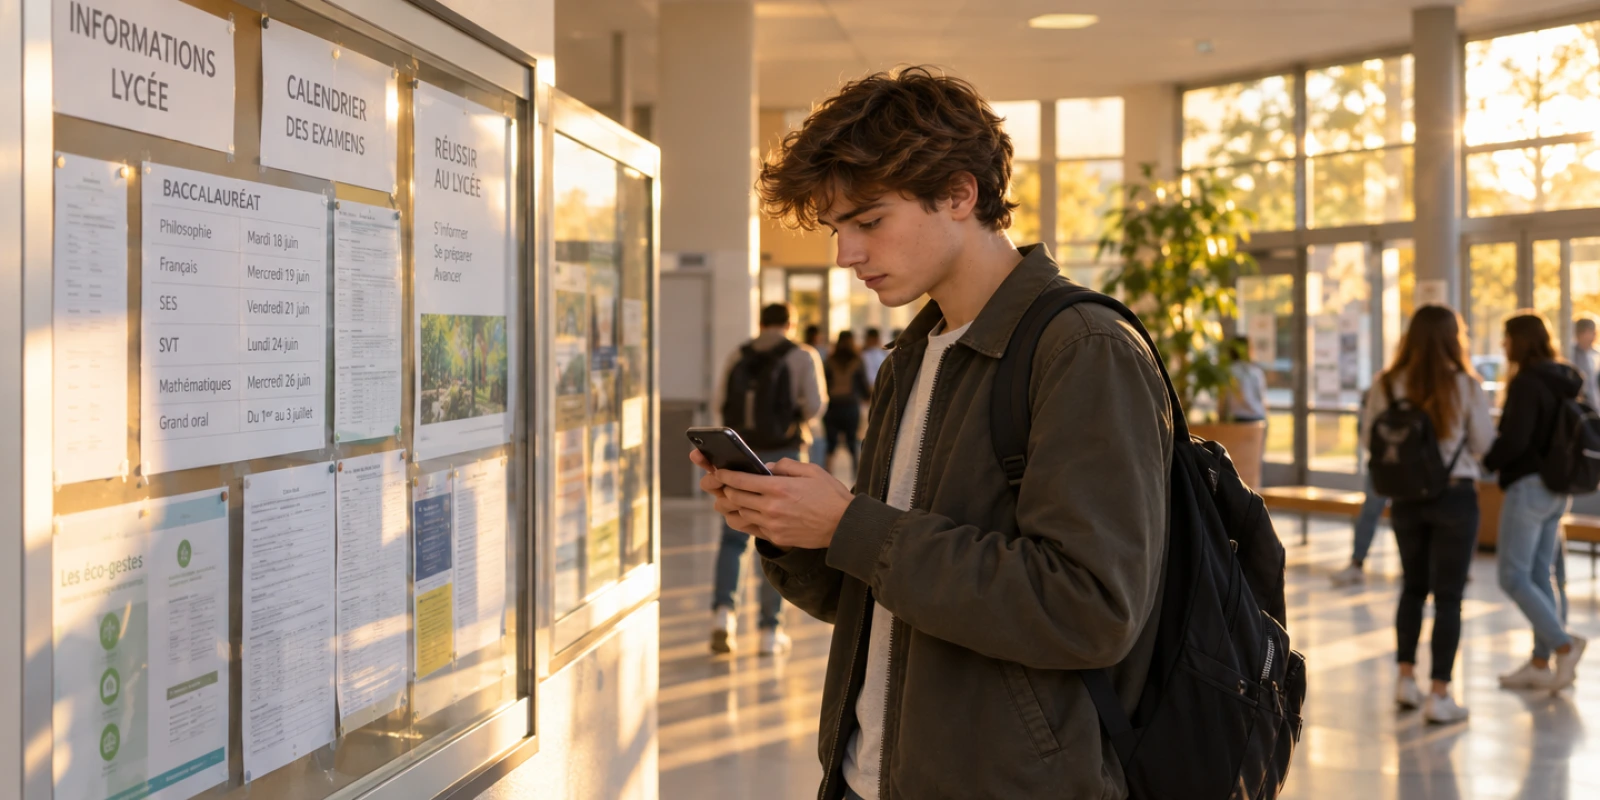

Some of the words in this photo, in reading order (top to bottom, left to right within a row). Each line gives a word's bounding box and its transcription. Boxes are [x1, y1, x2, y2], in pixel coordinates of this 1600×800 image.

[70, 1, 216, 78] INFORMATIONS
[111, 67, 169, 112] LYCÉE
[287, 74, 367, 122] CALENDRIER
[286, 115, 309, 141] DES
[312, 122, 365, 156] EXAMENS
[434, 135, 478, 169] RÉUSSIR
[434, 168, 450, 190] AU
[452, 173, 481, 198] LYCÉE
[163, 179, 261, 211] BACCALAURÉAT
[160, 218, 212, 240] Philosophie
[433, 221, 469, 240] S'informer
[247, 230, 271, 247] Mardi
[273, 233, 283, 249] 18
[284, 235, 299, 251] juin
[433, 243, 443, 259] Se
[444, 246, 472, 263] préparer
[159, 256, 198, 276] Français
[247, 264, 284, 282] Mercredi
[285, 268, 295, 283] 19
[296, 270, 310, 285] juin
[433, 266, 462, 284] Avancer
[159, 295, 178, 311] SES
[247, 299, 284, 315] Vendredi
[285, 301, 295, 316] 21
[296, 302, 310, 318] juin
[159, 337, 179, 353] SVT
[247, 337, 271, 352] Lundi
[272, 337, 283, 352] 24
[283, 338, 299, 354] juin
[159, 377, 232, 394] Mathématiques
[247, 374, 284, 390] Mercredi
[285, 373, 296, 389] 26
[296, 373, 311, 390] juin
[159, 413, 189, 430] Grand
[191, 412, 209, 428] oral
[247, 410, 260, 424] Du
[274, 413, 285, 422] au
[286, 407, 292, 421] 3
[293, 406, 313, 423] juillet
[61, 569, 81, 587] Les
[83, 554, 144, 582] éco-gestes
